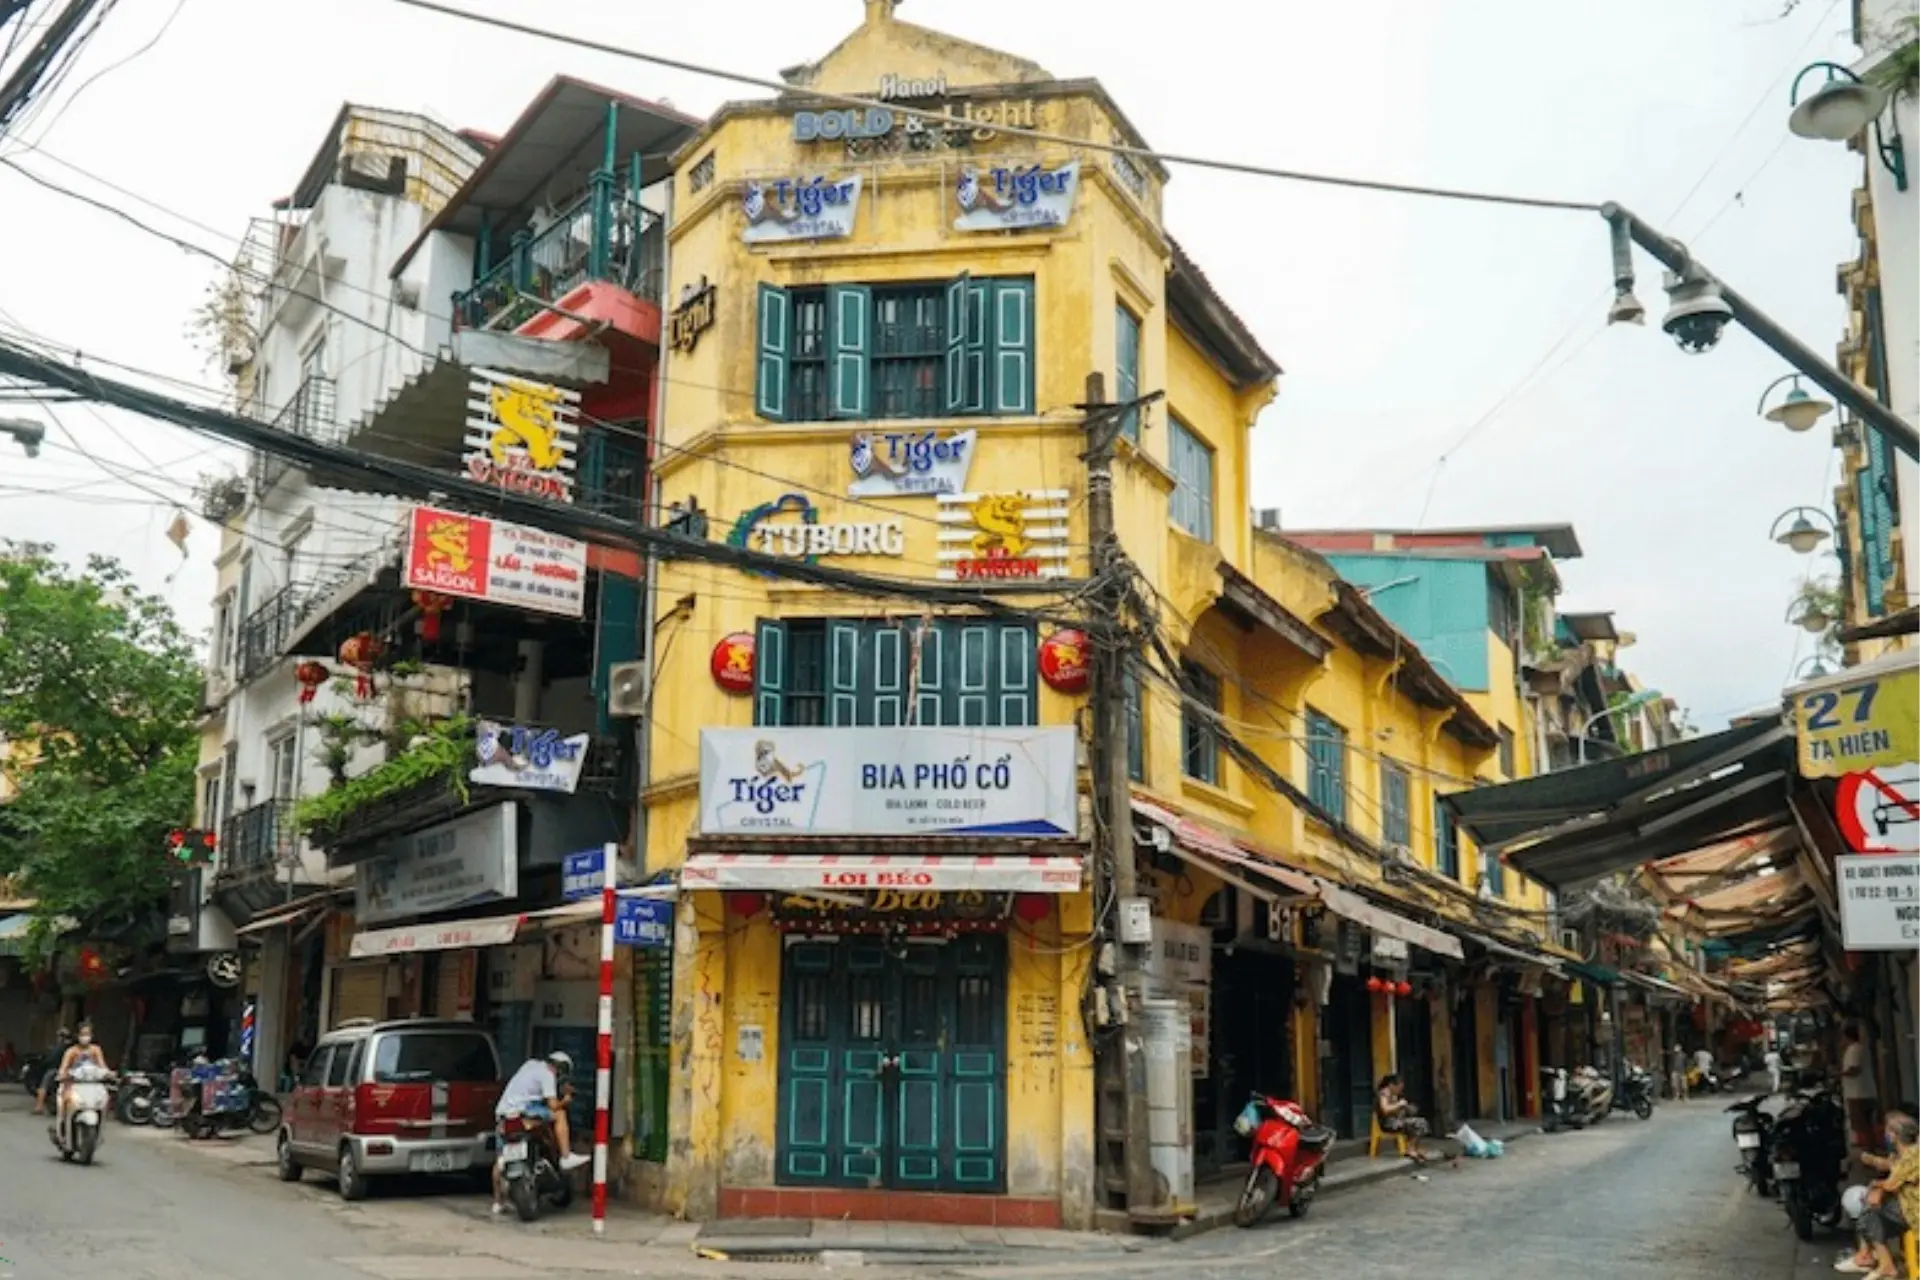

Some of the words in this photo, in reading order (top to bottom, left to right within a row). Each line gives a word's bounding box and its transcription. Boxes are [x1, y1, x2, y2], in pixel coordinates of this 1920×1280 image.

[879, 74, 947, 99] Hanoi
[791, 108, 896, 142] BOLD
[905, 114, 925, 134] &
[943, 99, 1035, 142] Light
[772, 176, 854, 216] Tiger
[988, 164, 1071, 205] Tiger
[885, 431, 967, 471] Tiger
[755, 522, 902, 557] TUBORG
[1804, 681, 1879, 730] 27
[862, 764, 906, 790] BIA
[914, 754, 971, 790] PHỐ
[976, 752, 1012, 790] CỔ
[728, 775, 806, 814] Tiger
[740, 817, 793, 829] CRYSTAL
[1268, 901, 1300, 943] Ba
